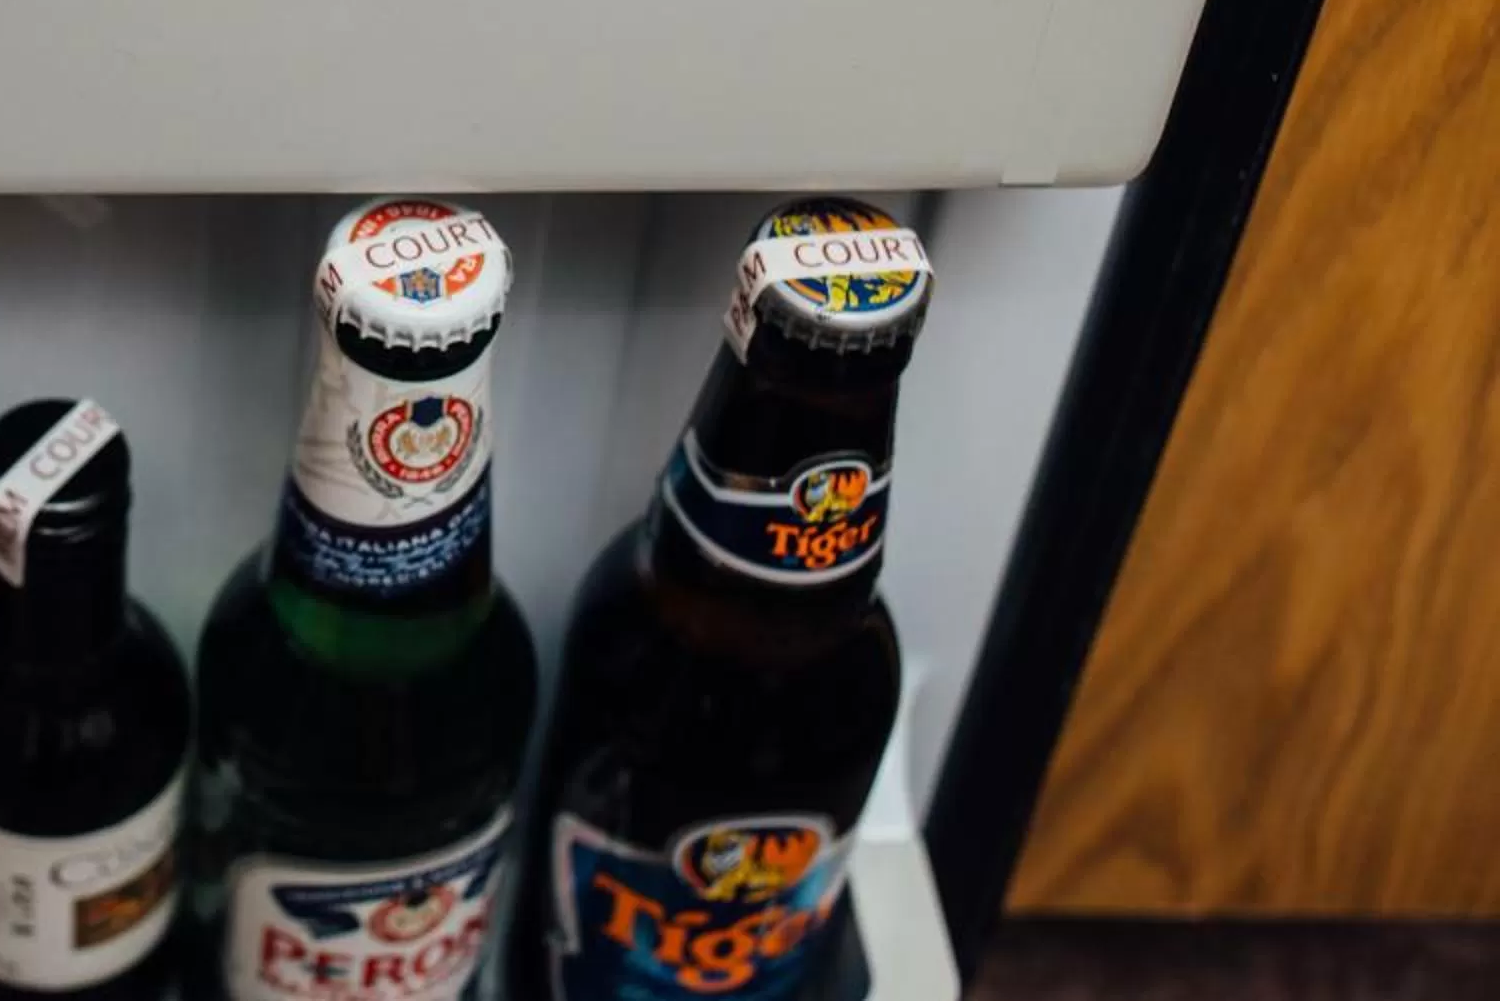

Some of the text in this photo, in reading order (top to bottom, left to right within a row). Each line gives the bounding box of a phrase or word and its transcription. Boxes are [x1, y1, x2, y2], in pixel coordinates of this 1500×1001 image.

[365, 218, 494, 269] COURT
[793, 236, 925, 269] COURT
[766, 514, 878, 571] Tiger
